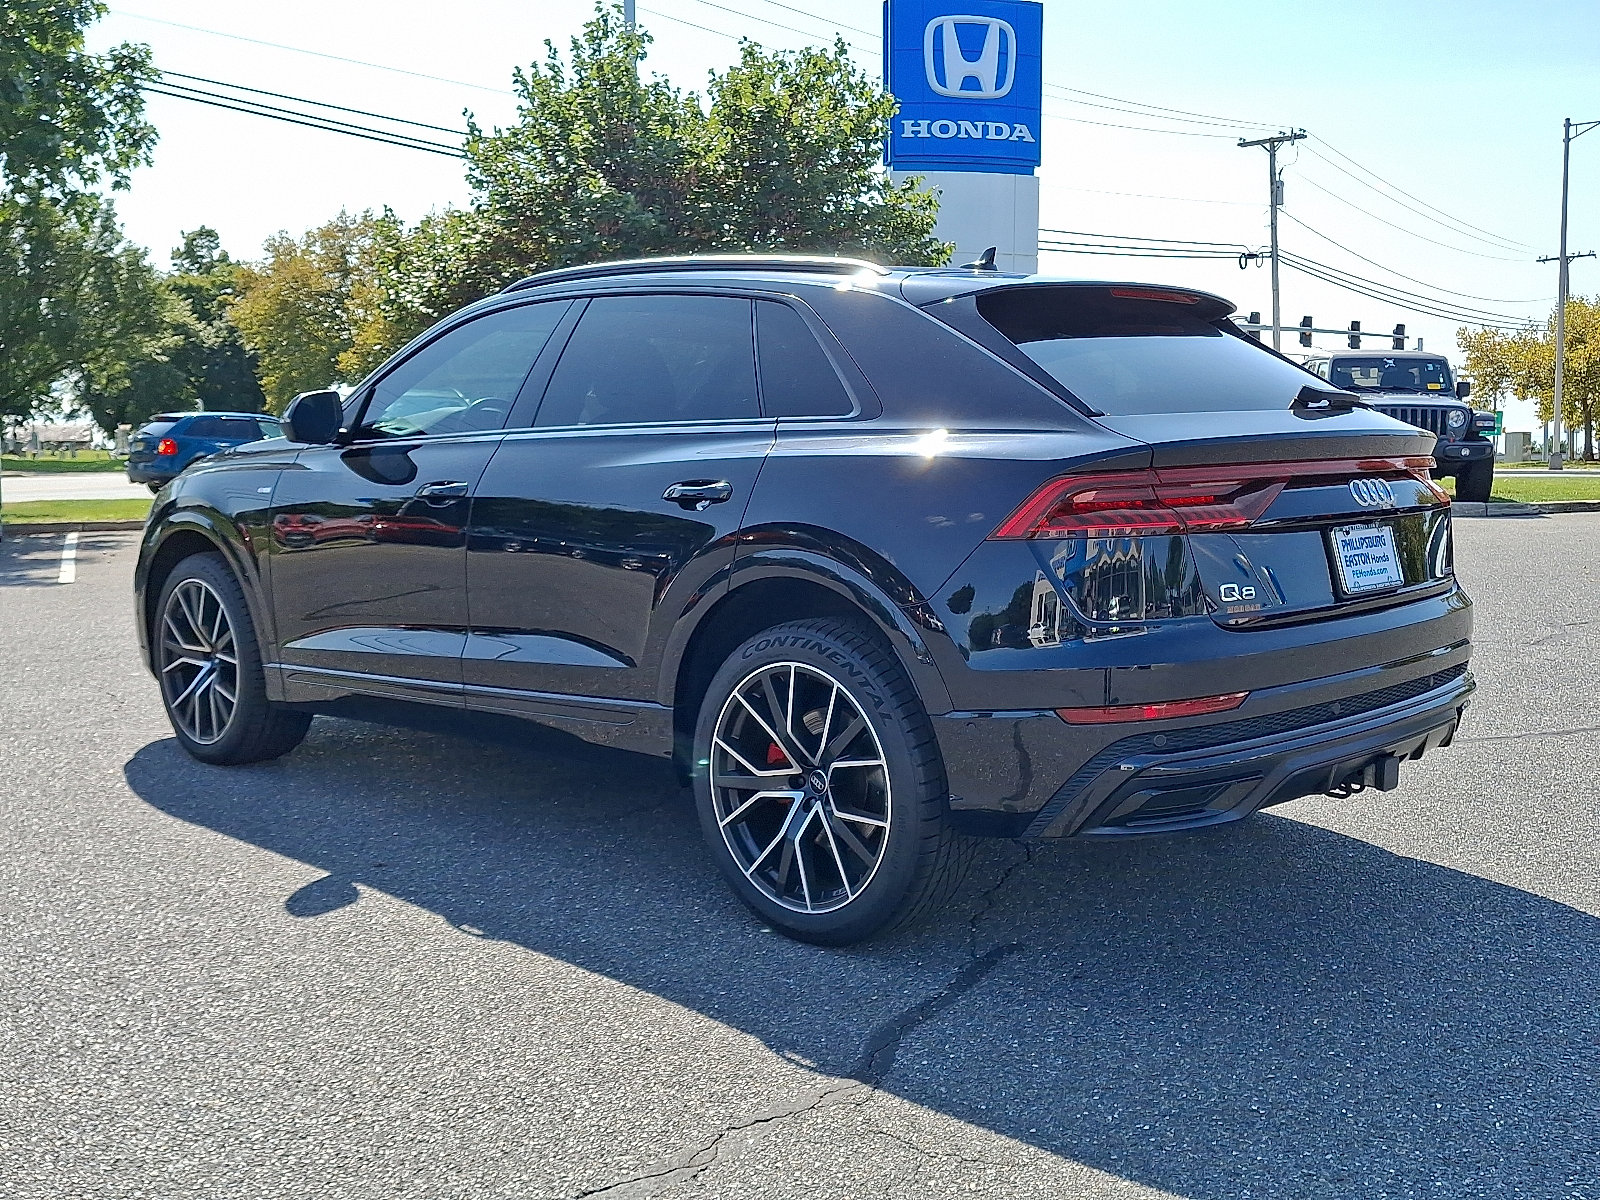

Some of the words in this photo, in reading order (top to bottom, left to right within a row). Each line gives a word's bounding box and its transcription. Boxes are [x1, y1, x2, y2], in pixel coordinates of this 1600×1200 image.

[901, 119, 1036, 143] HONDA
[1340, 534, 1387, 552] PHILLIPSBURG
[1344, 551, 1371, 568] EASTON
[1370, 552, 1390, 565] Honda
[1352, 567, 1389, 579] PEHonda.com
[1219, 583, 1256, 602] Q8
[741, 635, 893, 727] CONTINENTAL
